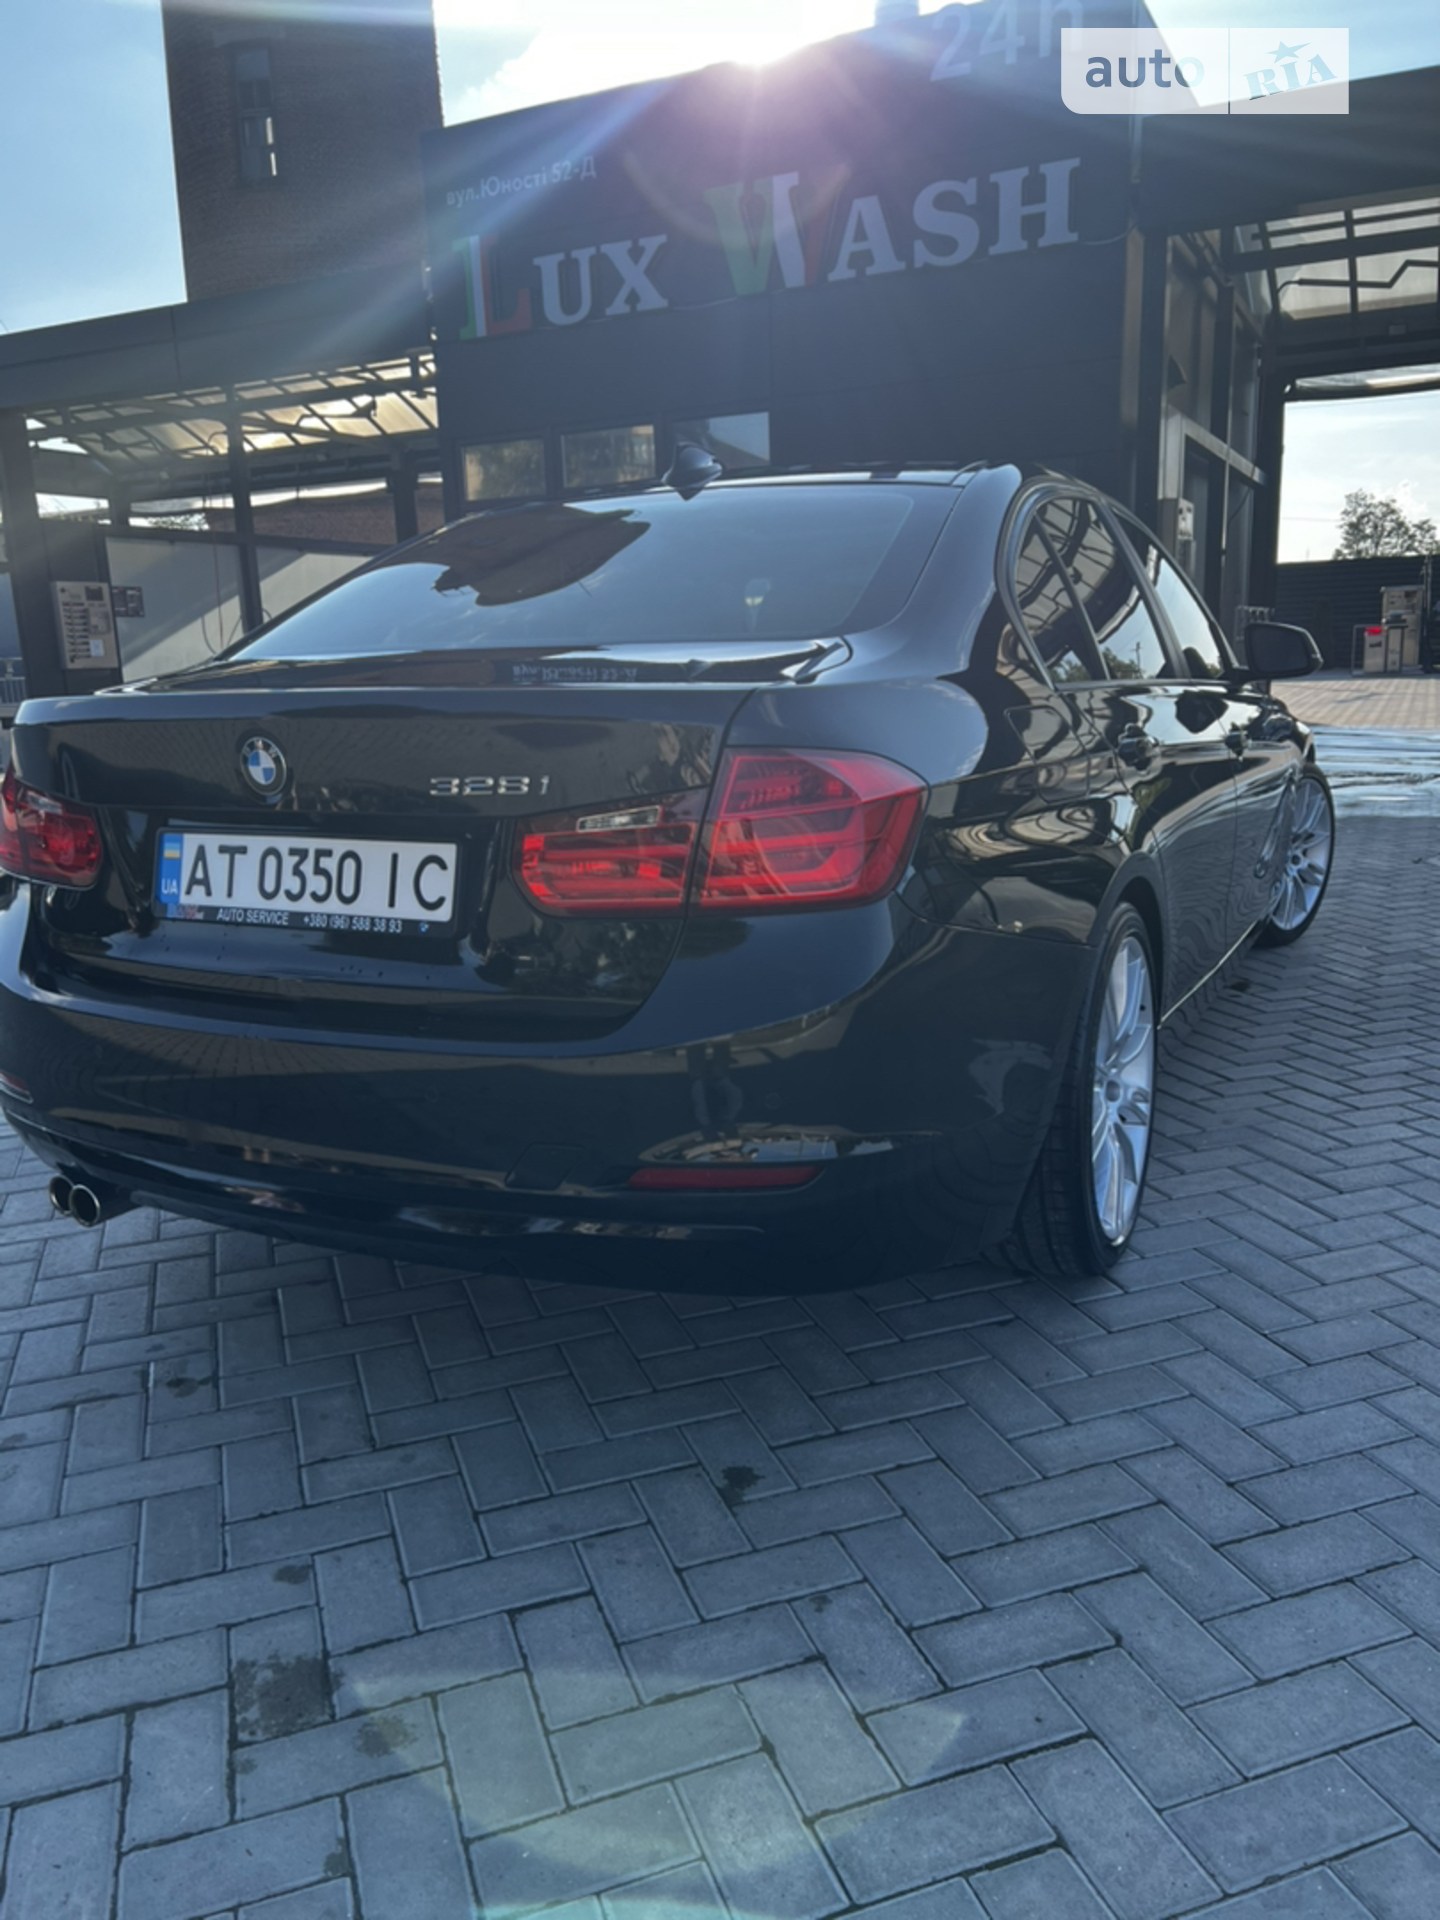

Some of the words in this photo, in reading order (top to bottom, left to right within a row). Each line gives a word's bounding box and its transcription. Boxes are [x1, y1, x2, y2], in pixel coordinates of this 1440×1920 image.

[551, 155, 597, 185] 52-Д
[453, 233, 669, 340] LUX
[704, 157, 1082, 296] WASH
[161, 878, 178, 895] UA
[184, 844, 248, 898] AT
[257, 846, 362, 905] 0350
[387, 852, 449, 911] IC
[216, 907, 245, 922] AUTO
[246, 909, 290, 926] SERVICE
[303, 913, 328, 928] +380
